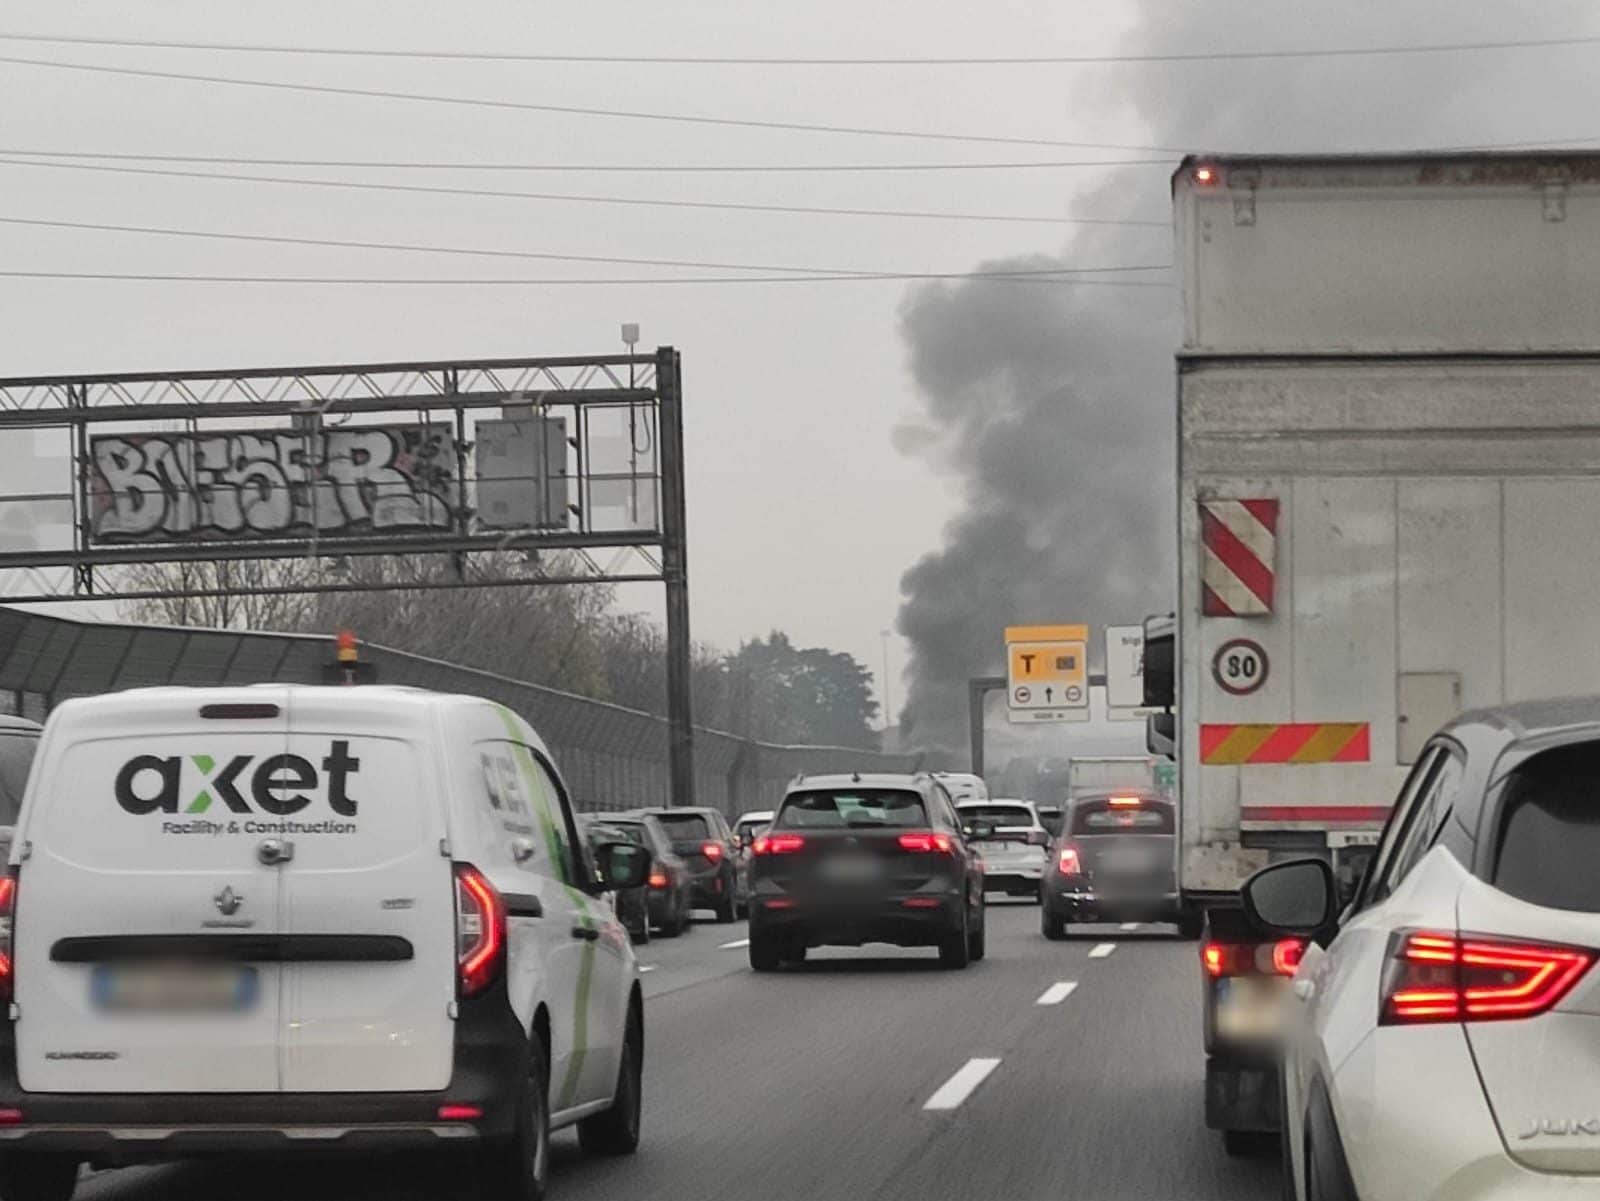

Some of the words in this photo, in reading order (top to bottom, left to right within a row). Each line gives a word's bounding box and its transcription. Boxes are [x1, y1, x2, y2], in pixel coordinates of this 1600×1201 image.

[1227, 654, 1257, 678] 80
[114, 739, 360, 817] axet
[162, 820, 222, 836] Facility
[226, 821, 240, 834] &
[244, 819, 357, 835] Construction
